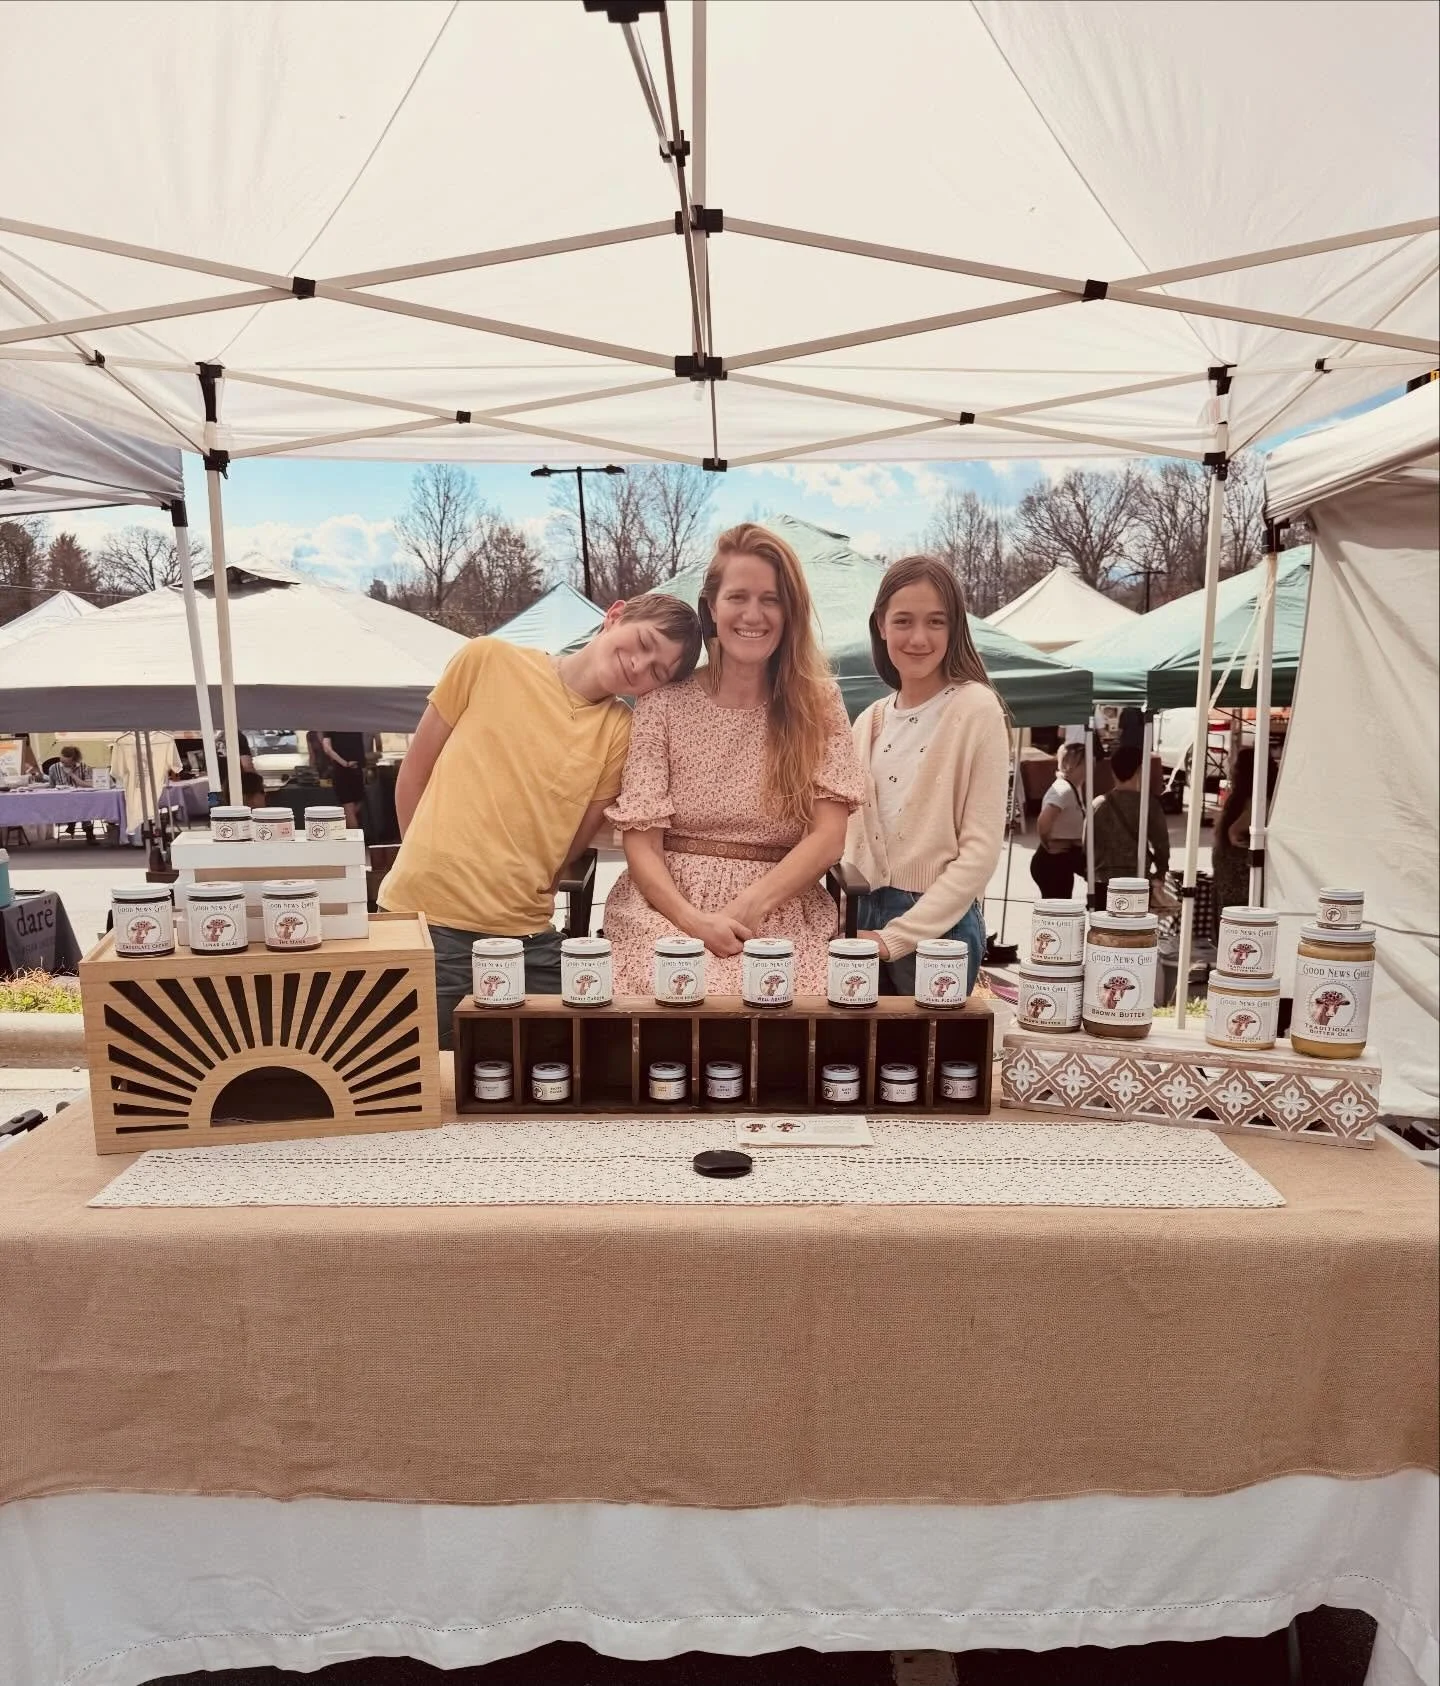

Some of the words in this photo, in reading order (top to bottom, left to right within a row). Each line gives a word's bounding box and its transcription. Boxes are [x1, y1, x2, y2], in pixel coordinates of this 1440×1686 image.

[17, 899, 54, 937] darë
[1113, 955, 1135, 964] NEWS
[1303, 964, 1325, 976] GOOD
[1328, 968, 1350, 978] NEWS
[1353, 968, 1370, 980] GHEE
[1091, 1009, 1117, 1017] BROWN
[1305, 1022, 1355, 1033] TRADITIONAL
[1309, 1029, 1335, 1037] BUTTER
